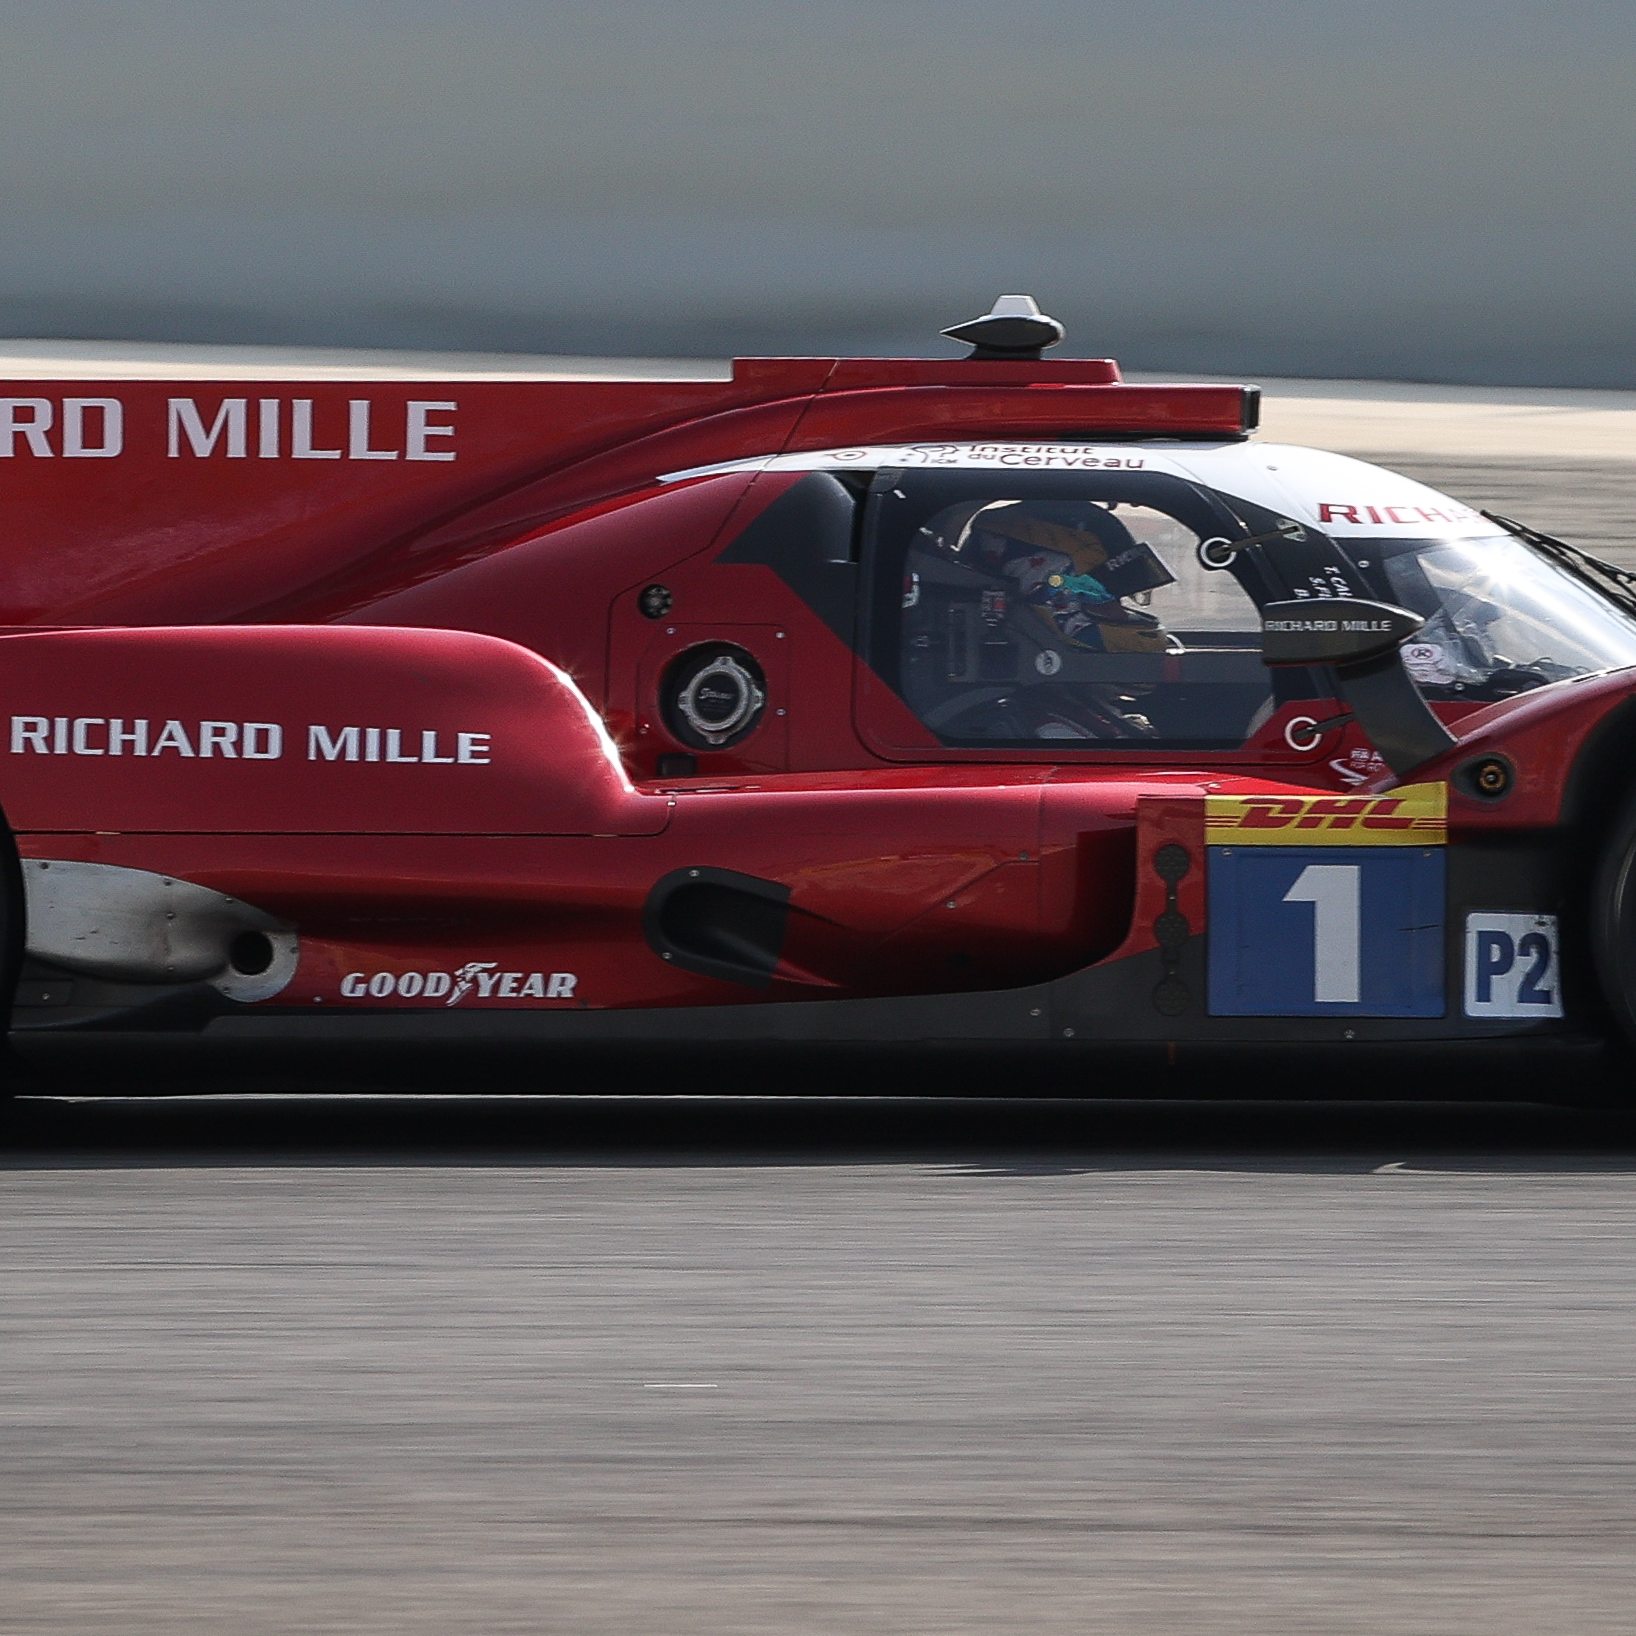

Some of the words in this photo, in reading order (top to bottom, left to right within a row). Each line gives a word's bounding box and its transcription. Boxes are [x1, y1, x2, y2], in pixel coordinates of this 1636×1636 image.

[167, 398, 457, 461] MILLE
[967, 452, 996, 460] du
[1000, 453, 1144, 469] Cerveau
[968, 445, 1096, 455] Institut
[1265, 620, 1338, 632] RICHARD
[1341, 620, 1392, 632] MILLE
[10, 715, 283, 761] RICHARD
[307, 724, 492, 765] MILLE
[1237, 798, 1416, 829] DHL
[1282, 864, 1362, 1003] 1
[340, 966, 578, 1002] GOODYEAR
[1474, 929, 1552, 1004] P2
